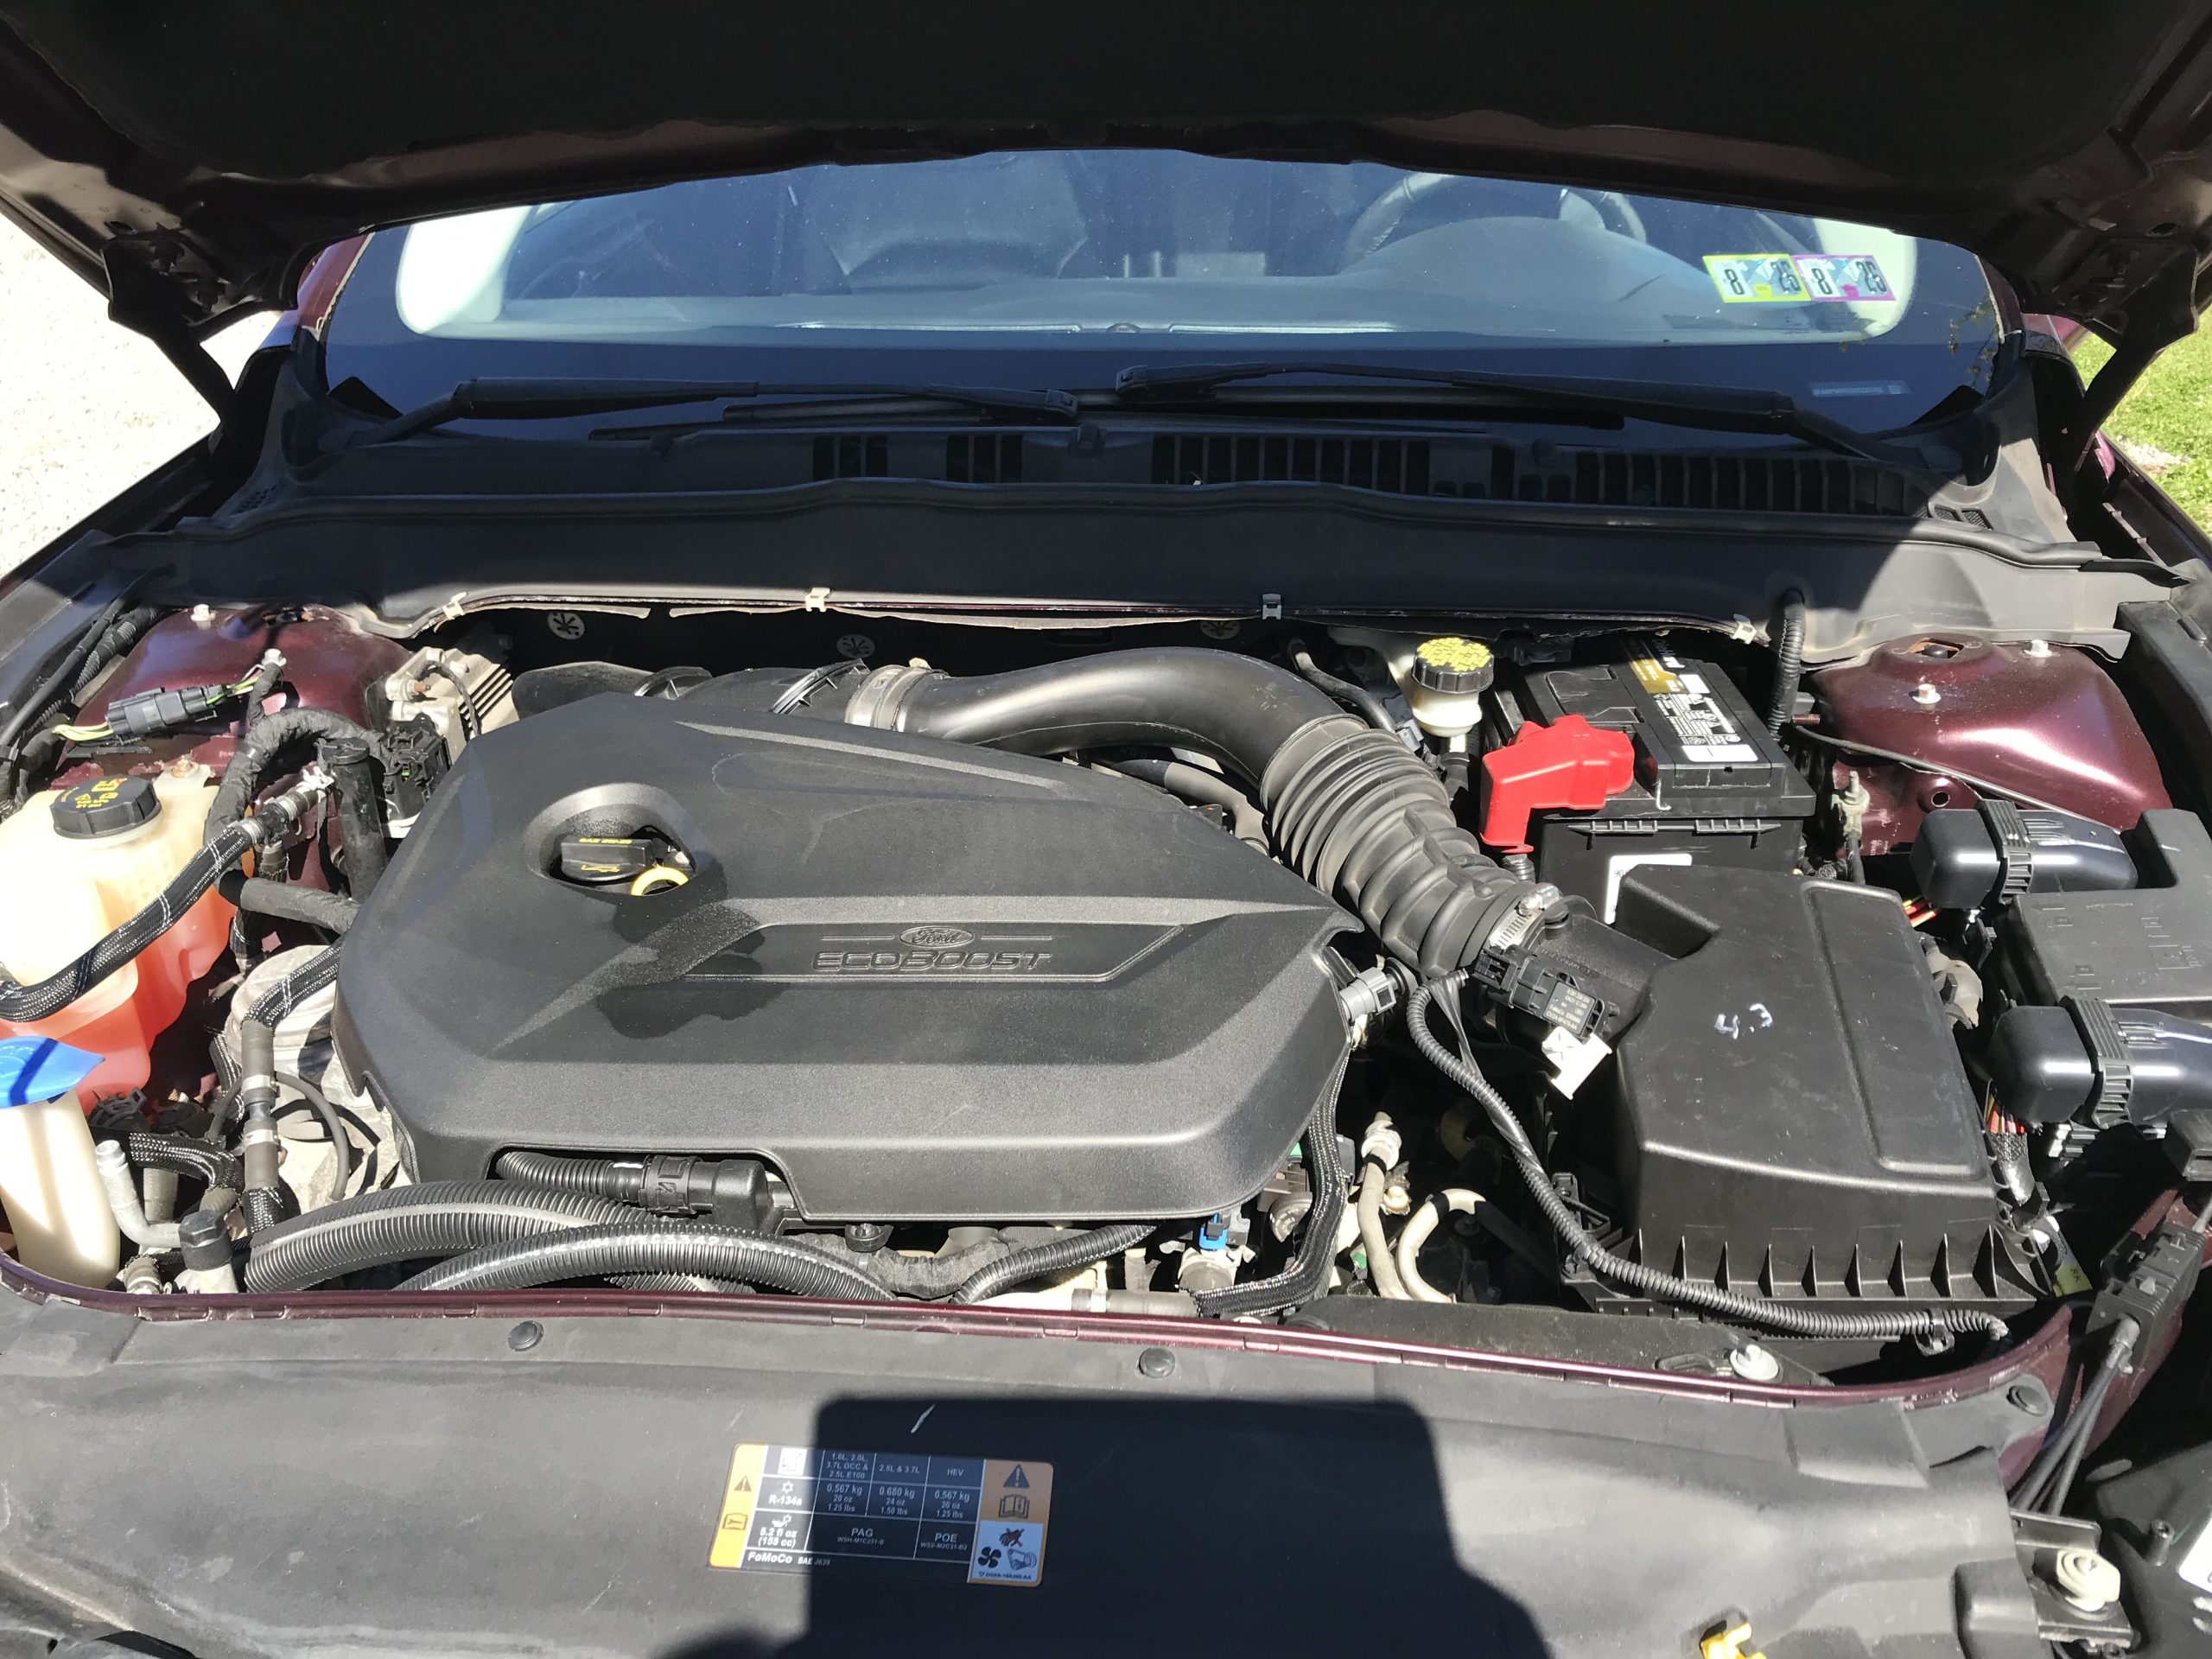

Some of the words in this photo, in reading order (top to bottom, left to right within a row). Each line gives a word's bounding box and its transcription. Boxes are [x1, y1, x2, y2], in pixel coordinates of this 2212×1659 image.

[1724, 269, 1745, 295] 8
[1811, 267, 1833, 295] 8
[812, 950, 1052, 972] ECOBOOST
[947, 1468, 964, 1477] HEV
[826, 1483, 850, 1493] 0.567
[851, 1484, 862, 1497] kg
[879, 1486, 903, 1497] 0.680
[904, 1487, 915, 1500] kg
[768, 1494, 803, 1506] R-134a
[833, 1494, 842, 1503] 20
[934, 1490, 958, 1500] 0.567
[959, 1491, 969, 1503] kg
[843, 1503, 855, 1512] lbs
[896, 1507, 908, 1516] lbs
[951, 1510, 963, 1518] lbs
[850, 1527, 874, 1537] PAG
[934, 1532, 958, 1543] POE
[780, 1538, 797, 1548] cc)
[747, 1551, 793, 1564] FoMoCo
[797, 1556, 812, 1566] SAE
